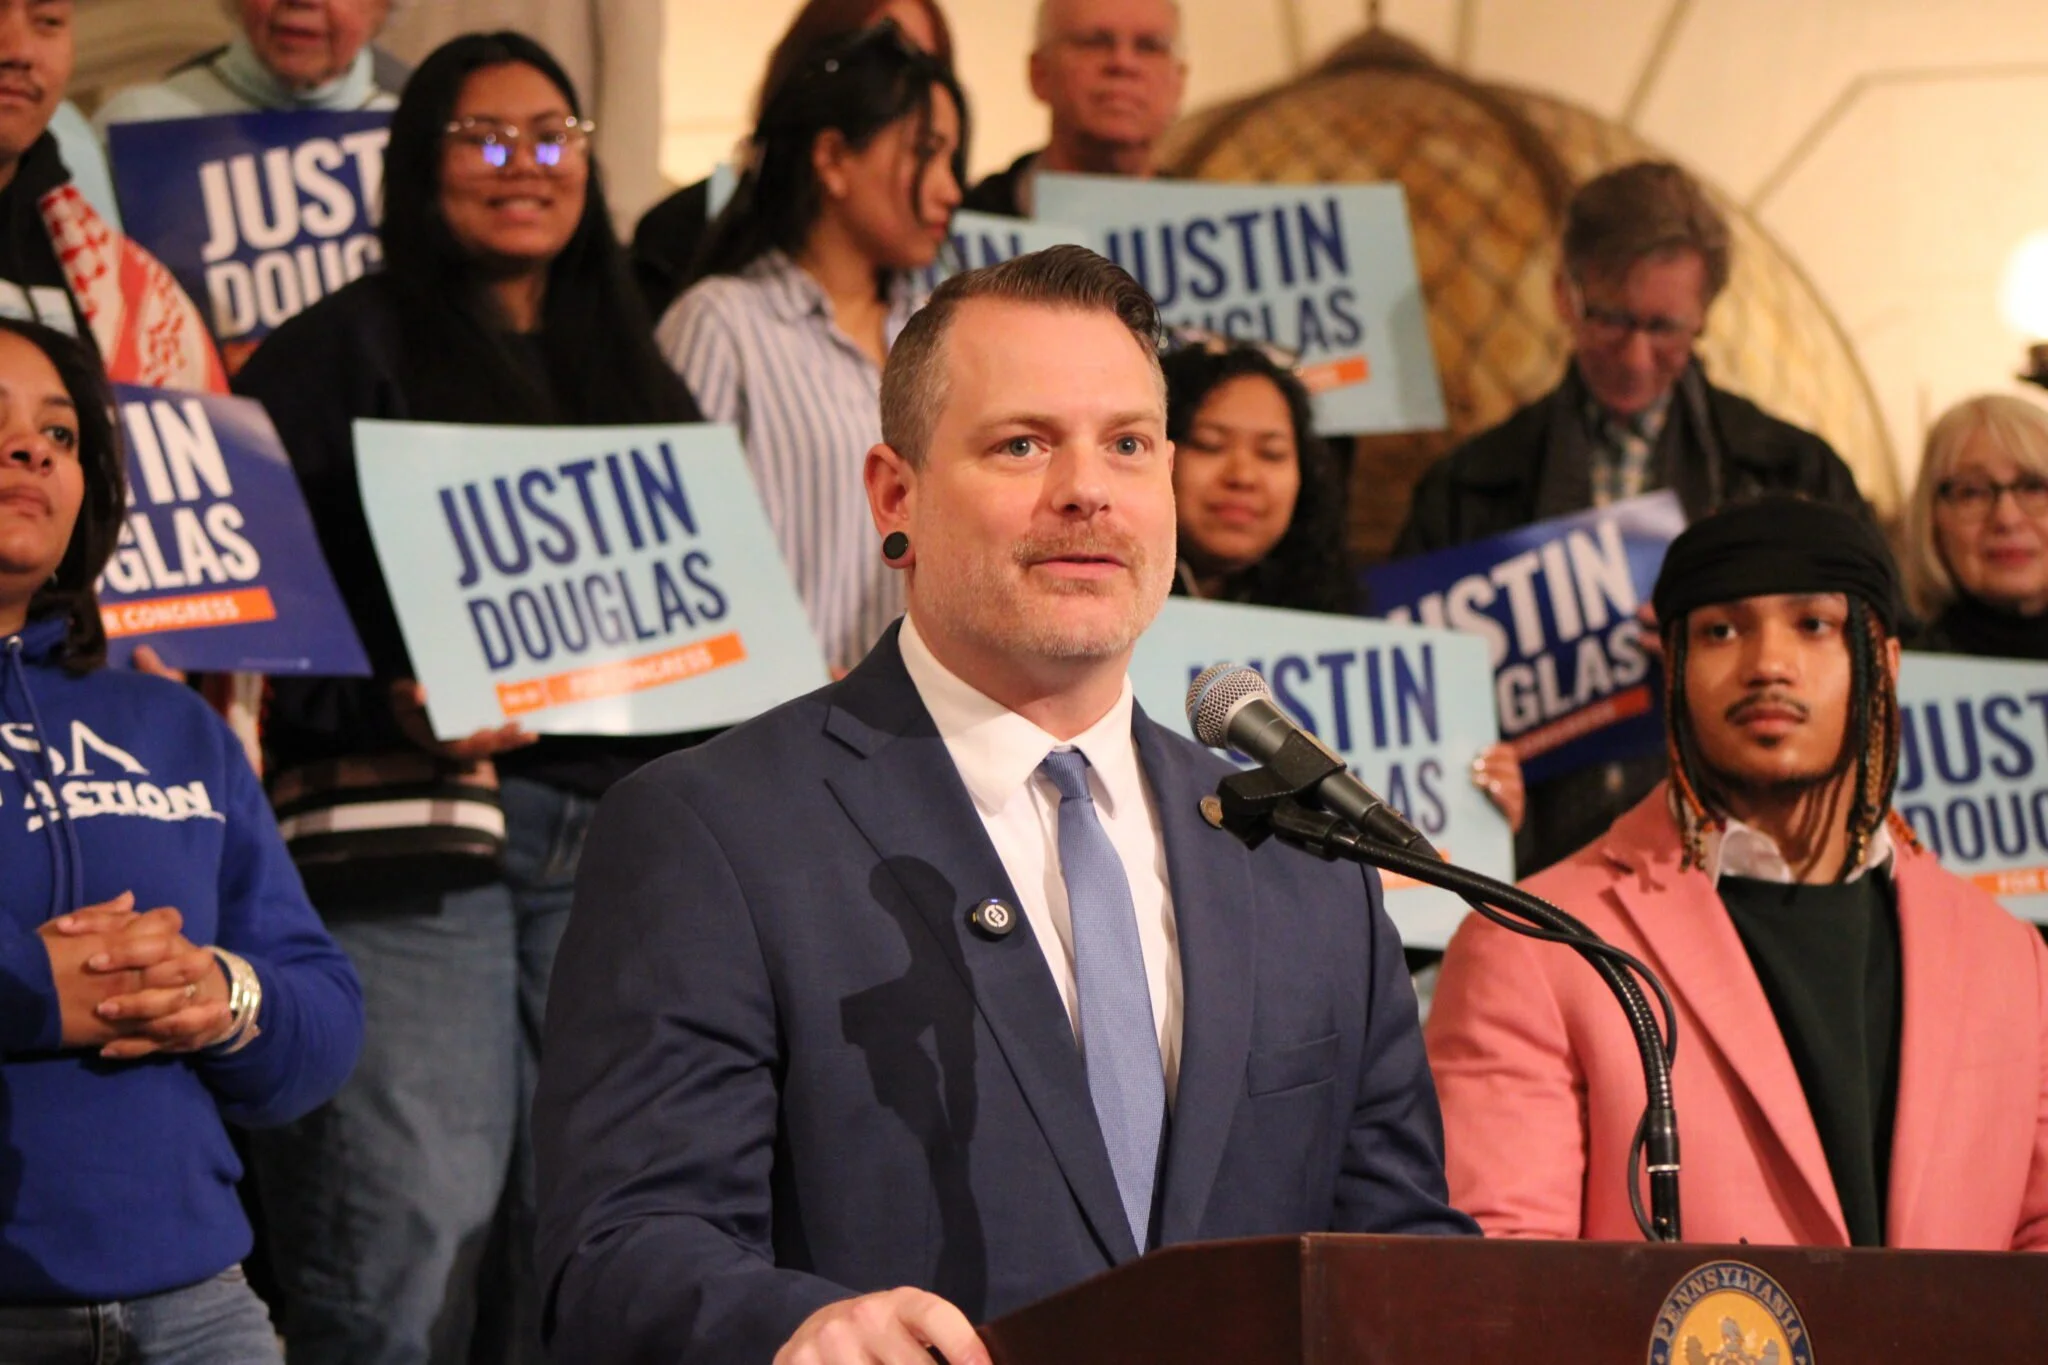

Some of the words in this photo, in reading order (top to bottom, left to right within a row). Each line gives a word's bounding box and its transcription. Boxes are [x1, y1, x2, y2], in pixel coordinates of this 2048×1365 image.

[438, 441, 698, 590] JUSTIN
[466, 551, 729, 672] DOUGLAS
[1387, 517, 1638, 667] STIN
[1187, 643, 1439, 766] STIN
[1655, 1266, 1802, 1341] PENNSYLVANIA
